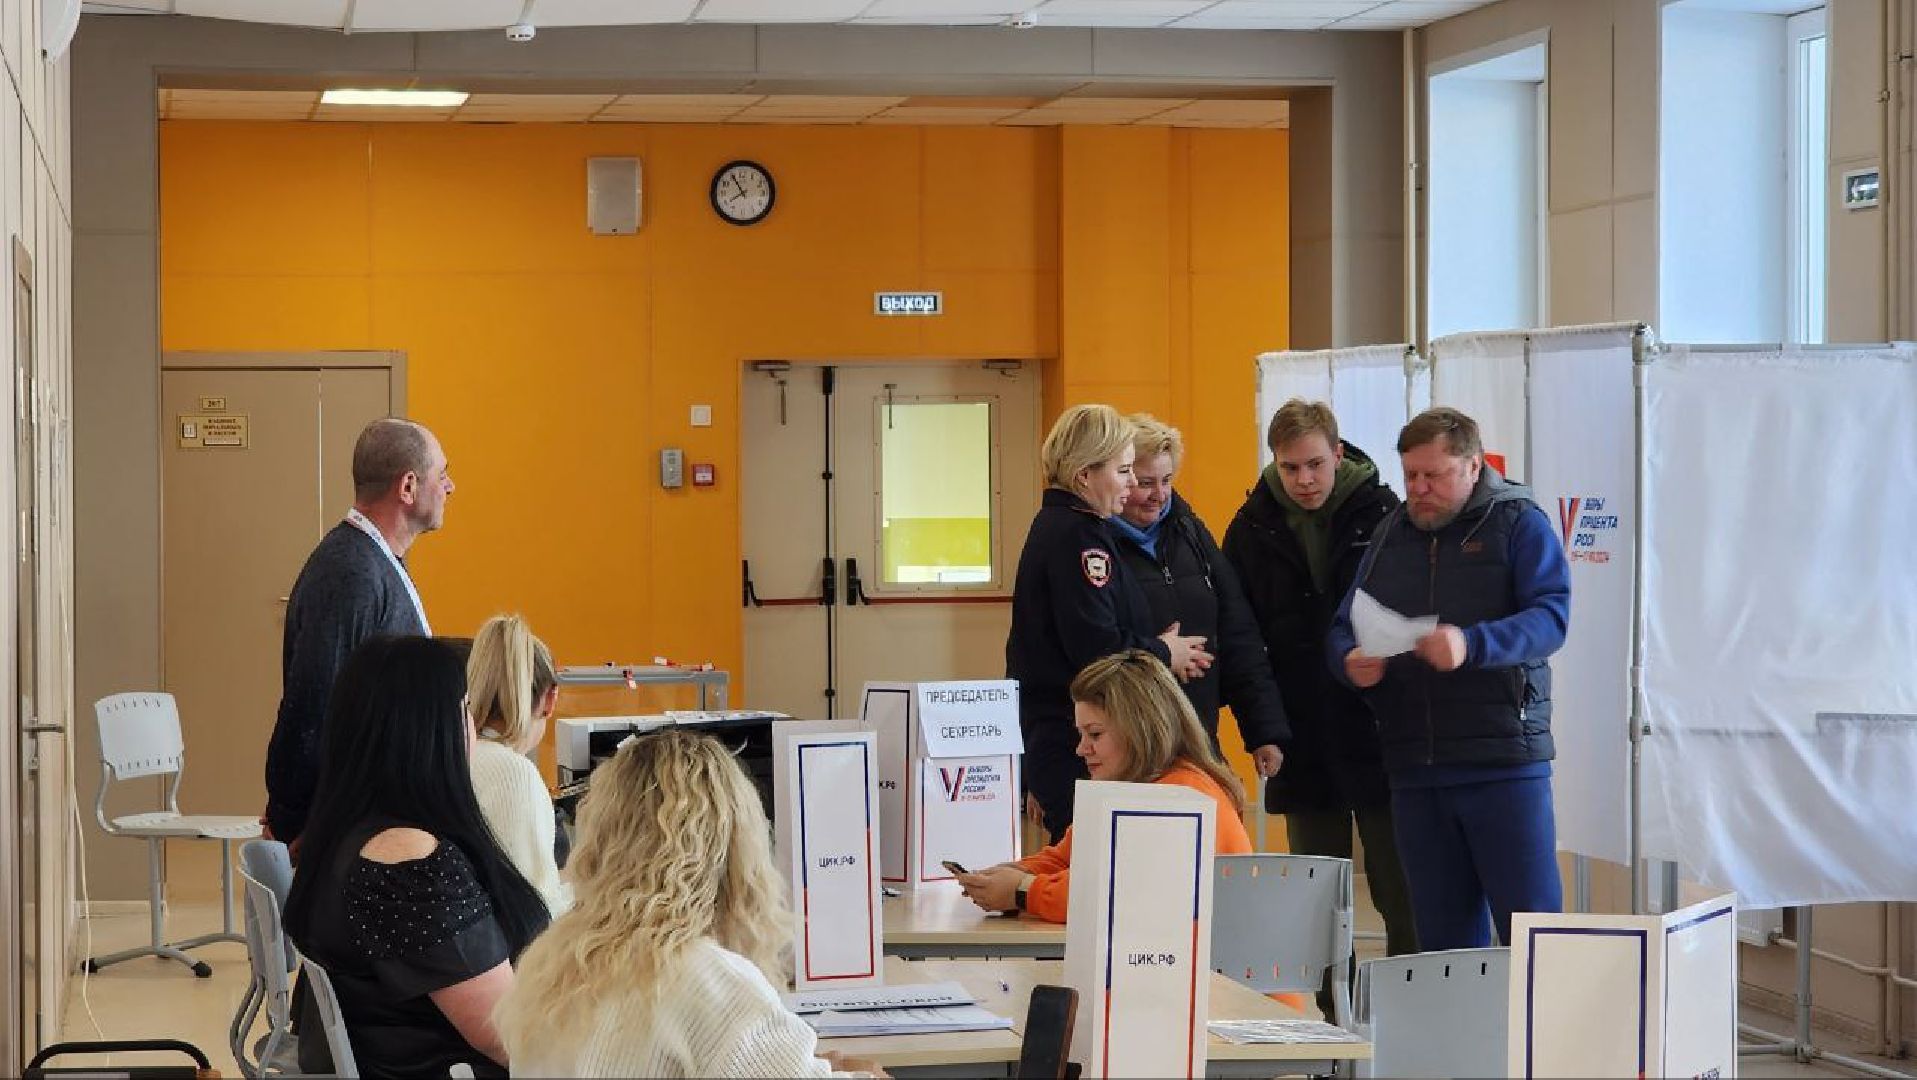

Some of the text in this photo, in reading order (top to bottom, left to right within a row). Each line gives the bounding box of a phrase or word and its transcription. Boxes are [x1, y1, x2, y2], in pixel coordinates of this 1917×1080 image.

[881, 297, 935, 311] ВЫХОД
[925, 688, 1010, 704] ПРЕДСЕДАТЕЛЬ
[941, 725, 1002, 739] СЕКРЕТАРЬ
[818, 855, 856, 868] ЦИК.РФ
[1128, 953, 1176, 967] ЦИК.РФ
